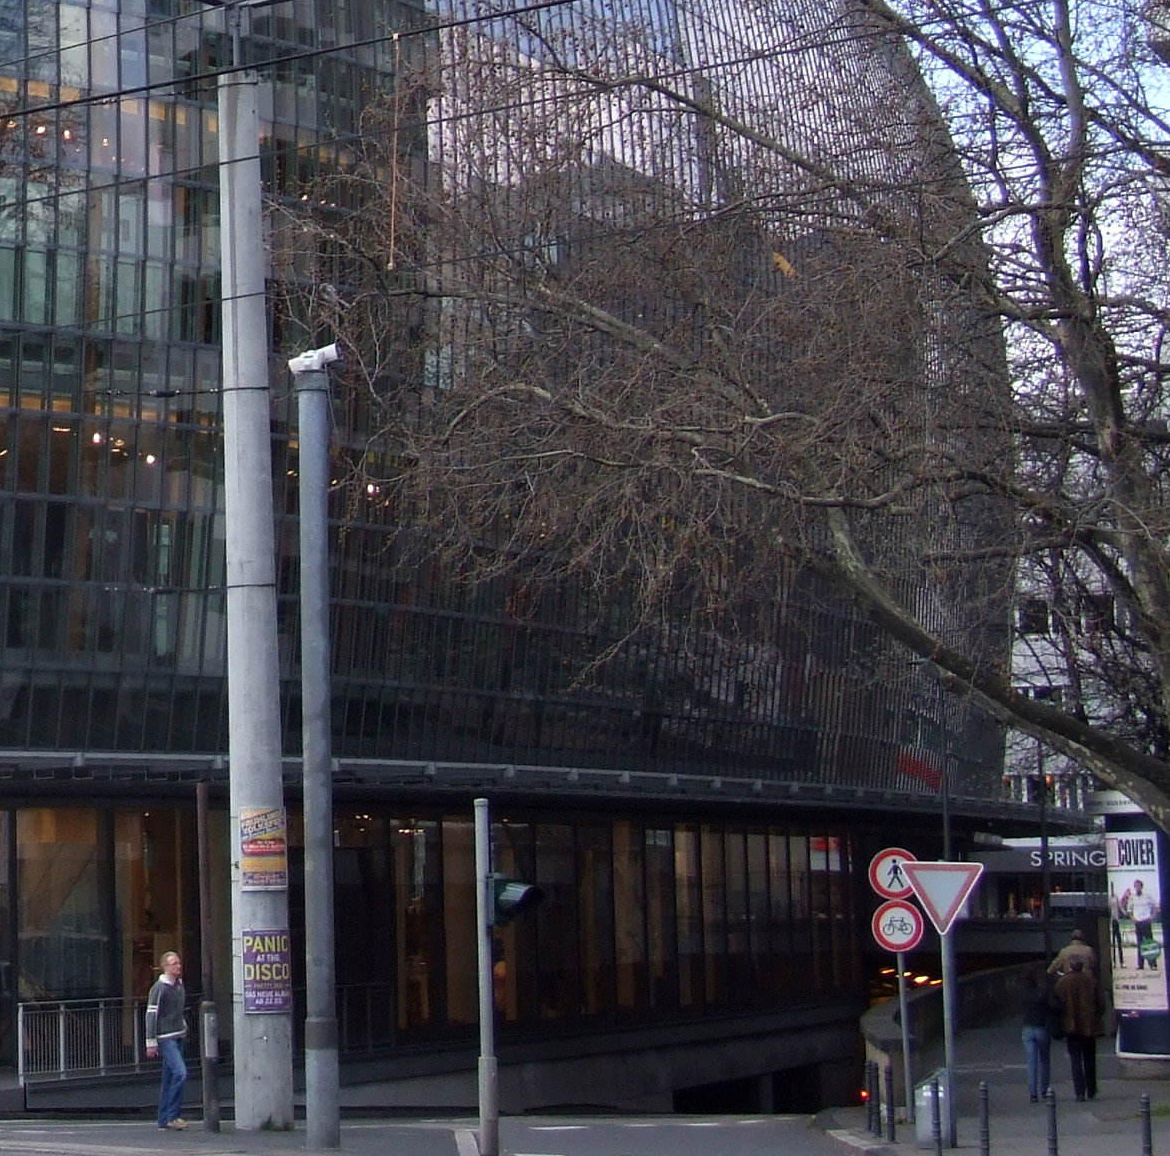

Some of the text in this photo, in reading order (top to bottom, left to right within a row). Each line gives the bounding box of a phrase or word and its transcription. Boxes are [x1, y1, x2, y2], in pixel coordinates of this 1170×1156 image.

[1117, 838, 1155, 866] COVER
[243, 935, 288, 953] PANIC
[256, 954, 281, 962] AT THE
[244, 964, 289, 981] DISCO
